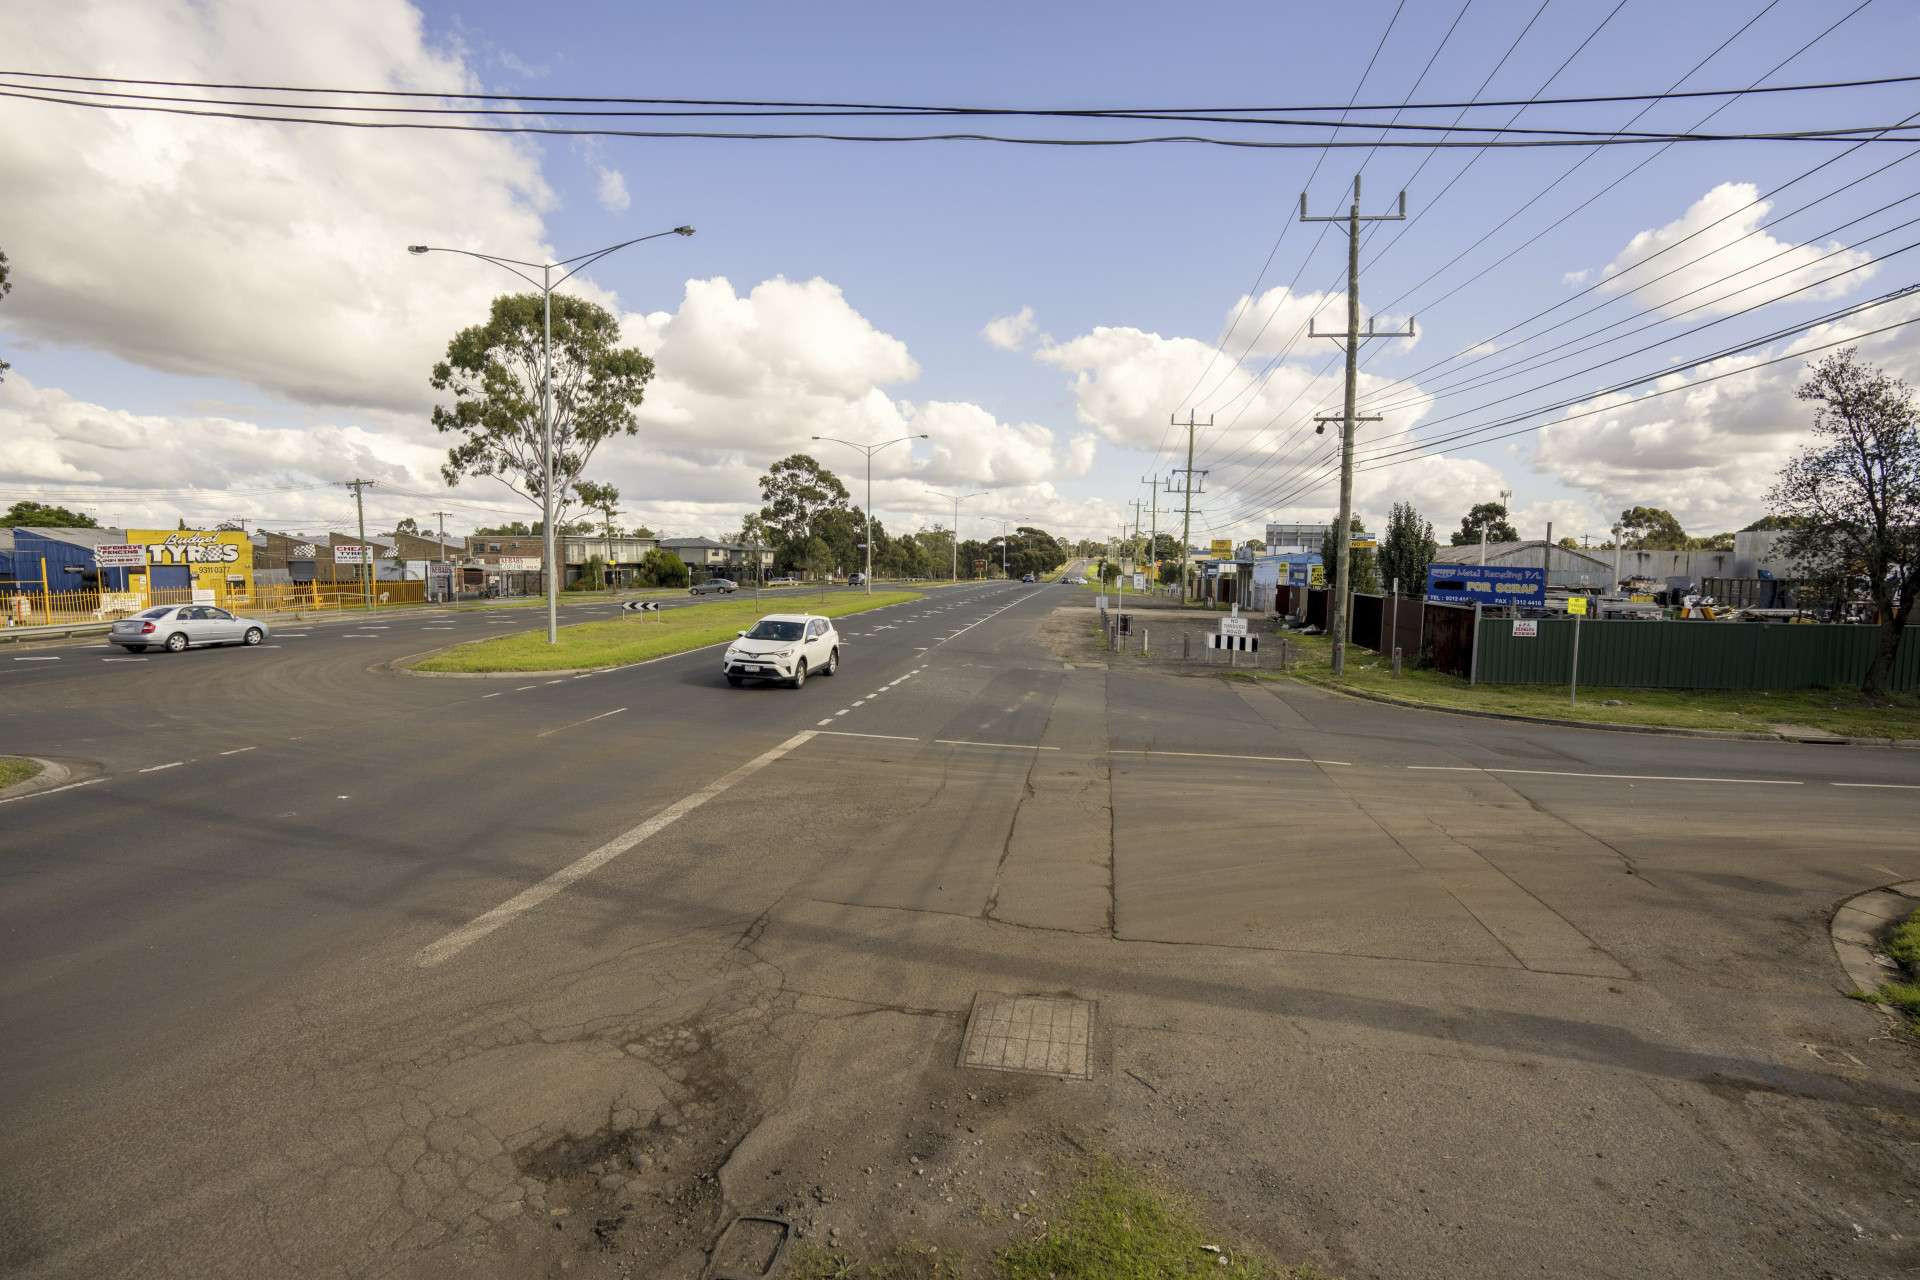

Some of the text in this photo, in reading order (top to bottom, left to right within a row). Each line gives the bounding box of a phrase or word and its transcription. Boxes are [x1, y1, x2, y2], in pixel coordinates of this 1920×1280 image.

[1457, 569, 1481, 577] Metal
[1466, 581, 1538, 595] FOR SCRAP
